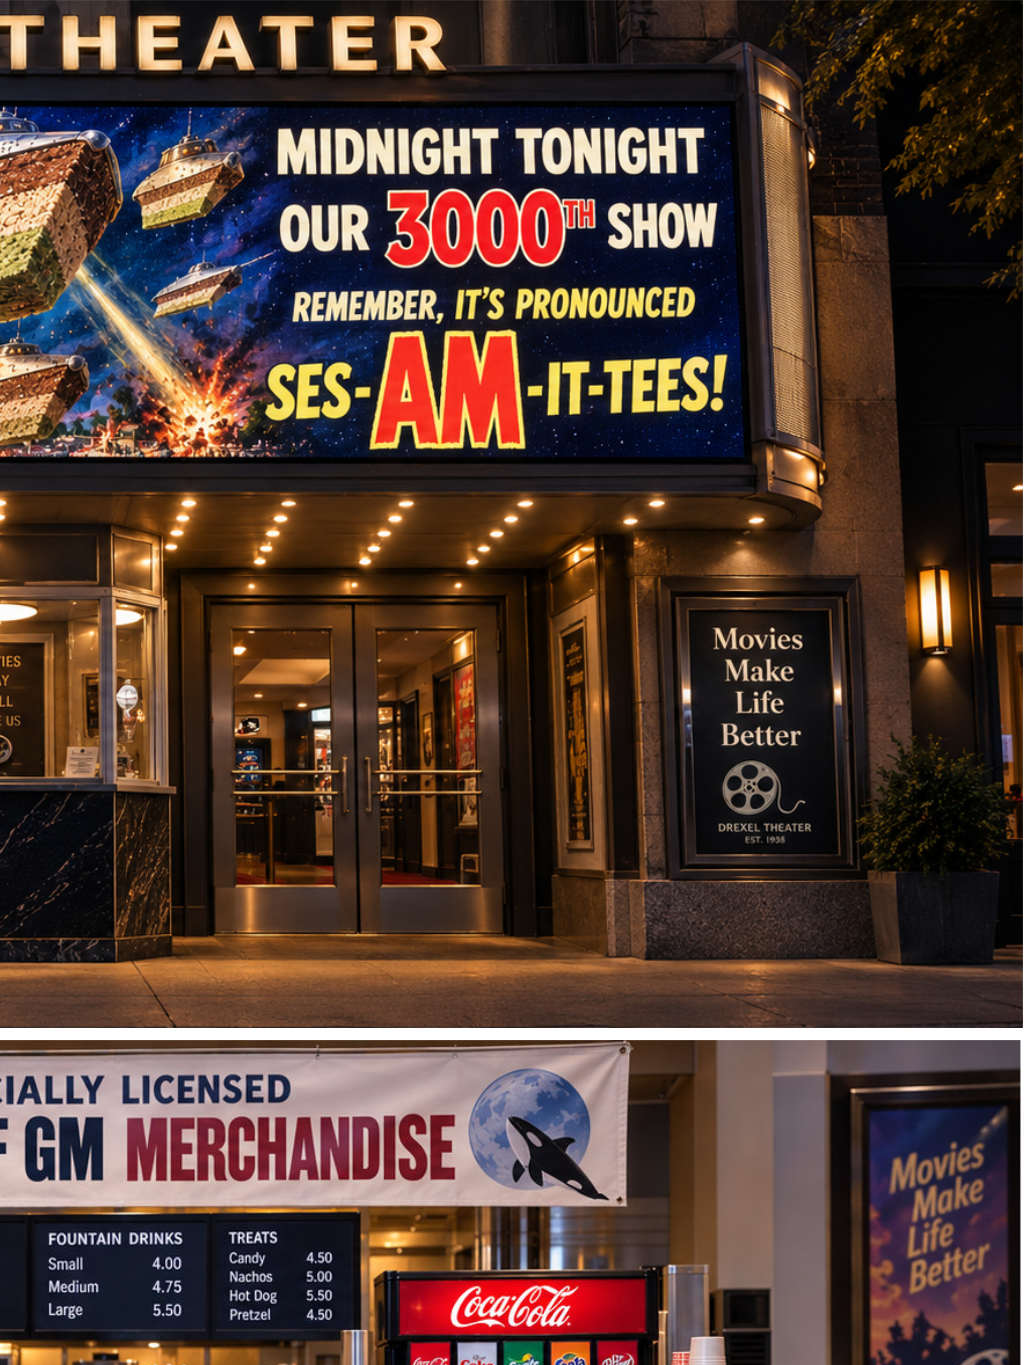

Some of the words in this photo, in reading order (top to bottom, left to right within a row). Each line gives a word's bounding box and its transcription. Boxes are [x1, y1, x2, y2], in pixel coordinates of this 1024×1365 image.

[277, 128, 500, 175] MIDNIGHT
[515, 127, 704, 174] TONIGHT
[279, 204, 370, 252] OUR
[607, 202, 717, 249] SHOW
[292, 289, 444, 324] REMEMBER,
[455, 288, 504, 320] IT'S
[515, 287, 696, 320] PRONOUNCED
[712, 627, 804, 650] Movies
[725, 659, 795, 682] Make
[736, 691, 784, 714] Life
[6, 715, 21, 727] US
[721, 723, 801, 746] Better
[718, 823, 760, 832] DREXEL
[763, 823, 812, 832] THEATER
[122, 1074, 292, 1105] LICENSED
[24, 1115, 104, 1182] GM
[126, 1113, 456, 1183] MERCHANDISE
[48, 1232, 122, 1246] FOUNTAIN
[128, 1232, 183, 1246] DRINKS
[229, 1231, 278, 1244] TREATS
[48, 1256, 83, 1271] Small
[152, 1256, 182, 1270] 4.00
[229, 1251, 265, 1267] Candy
[306, 1251, 333, 1265] 4.50
[229, 1270, 273, 1283] Nachos
[306, 1270, 333, 1283] 5.00
[48, 1279, 99, 1294] Medium
[152, 1280, 182, 1294] 4.75
[229, 1289, 250, 1302] Hot
[254, 1289, 277, 1305] Dog
[306, 1289, 333, 1302] 5.50
[48, 1303, 83, 1319] Large
[152, 1303, 182, 1317] 5.50
[229, 1307, 271, 1321] Pretzel
[306, 1308, 333, 1321] 4.50
[450, 1284, 579, 1329] Coca-Cola
